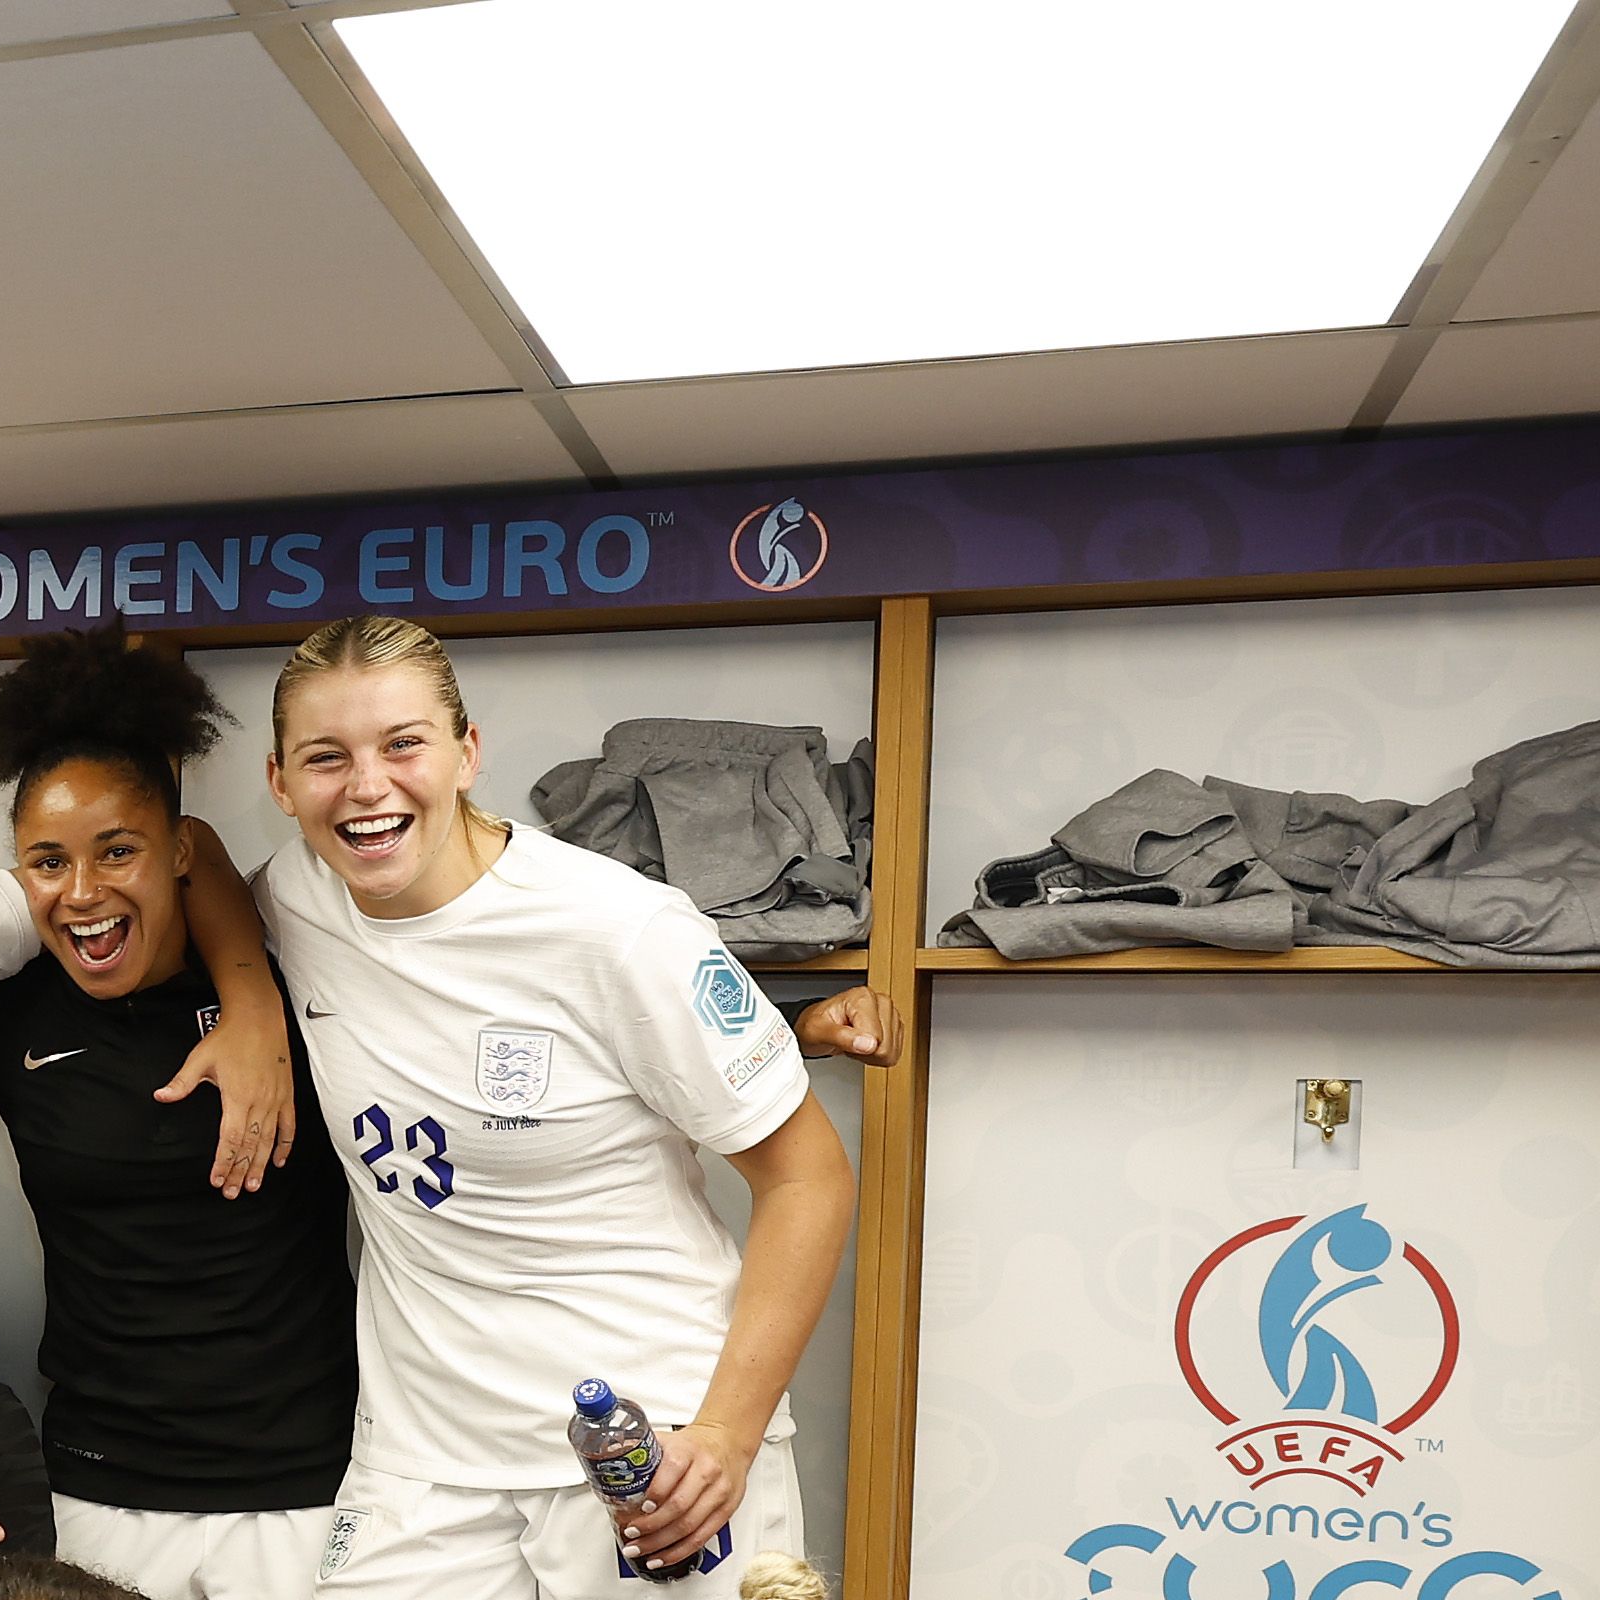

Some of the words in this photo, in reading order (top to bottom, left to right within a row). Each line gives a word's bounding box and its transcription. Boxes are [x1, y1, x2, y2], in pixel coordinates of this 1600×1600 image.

[358, 515, 653, 606] EURO
[482, 1120, 493, 1130] 26
[494, 1119, 517, 1130] JULY
[351, 1102, 457, 1211] 23
[1225, 1432, 1390, 1488] UEFA
[1165, 1496, 1454, 1548] women's
